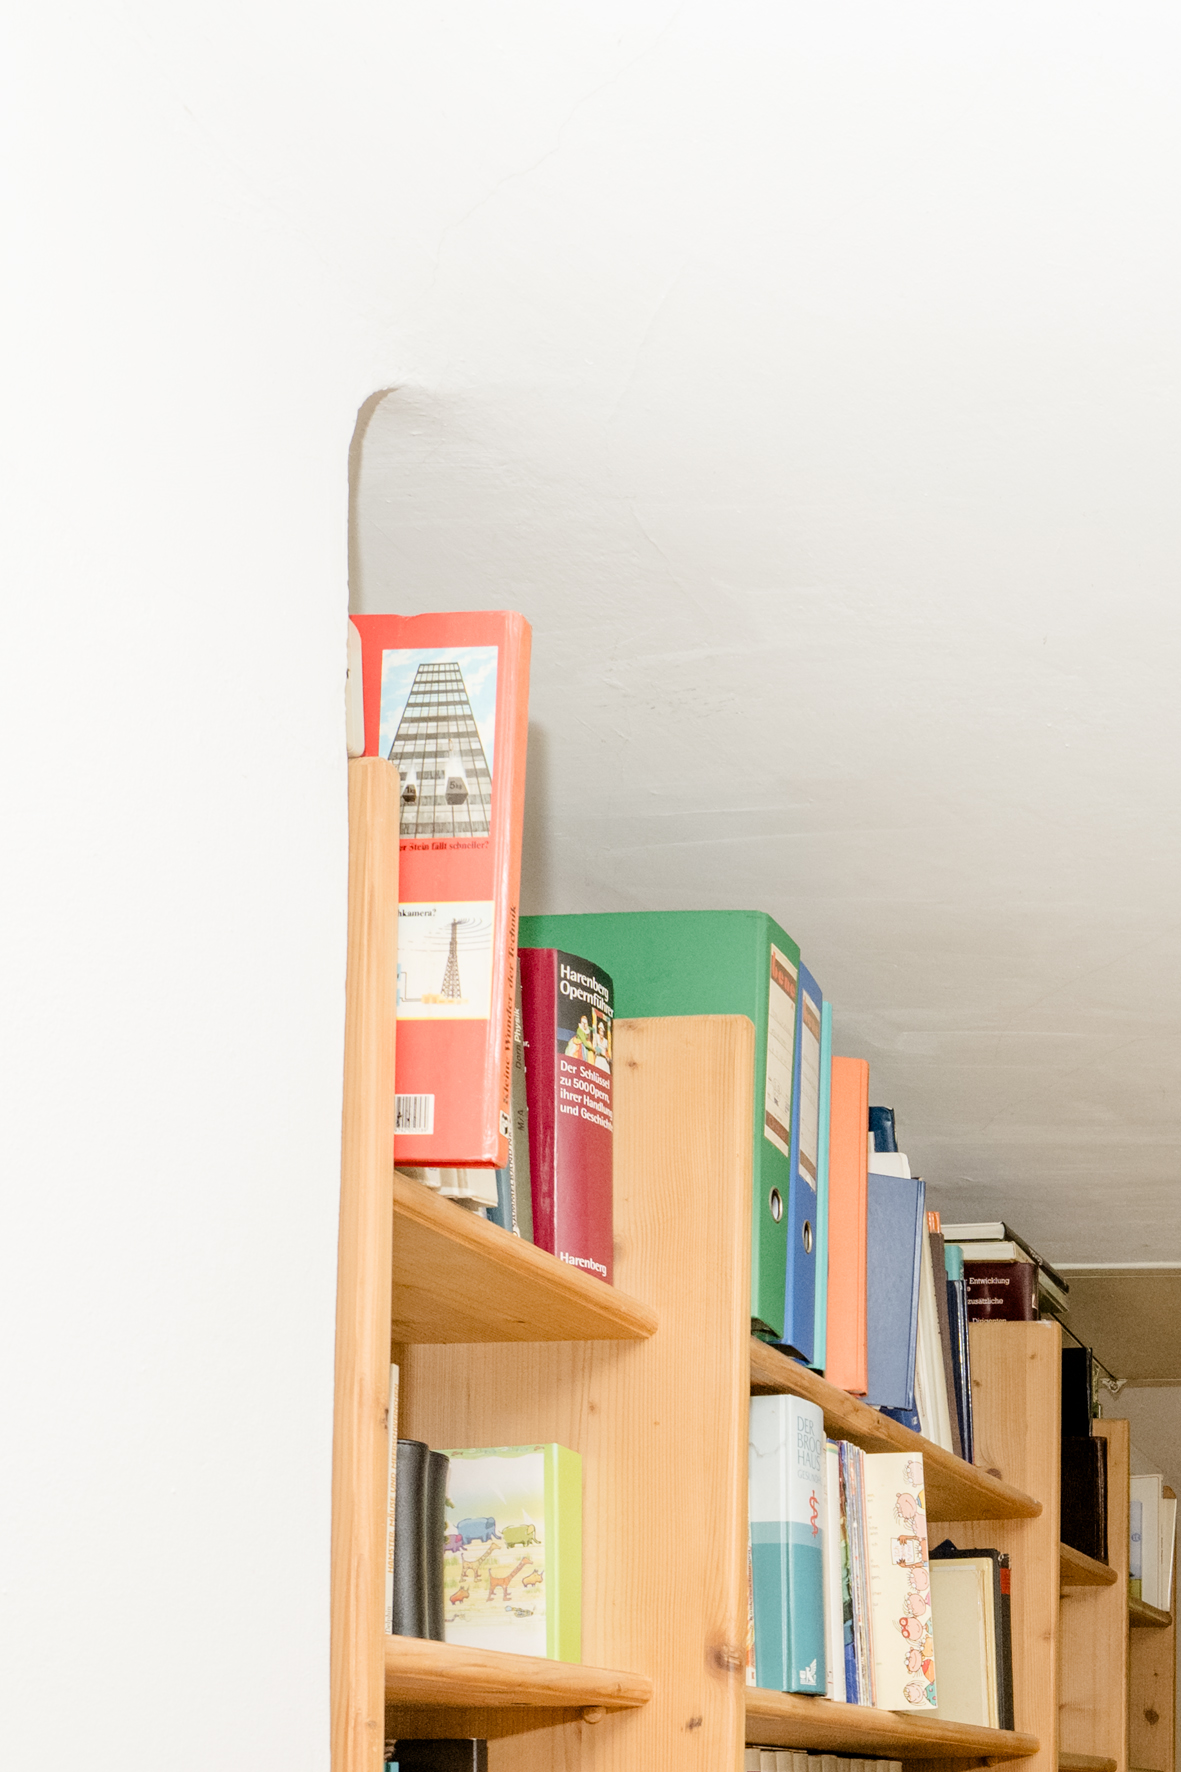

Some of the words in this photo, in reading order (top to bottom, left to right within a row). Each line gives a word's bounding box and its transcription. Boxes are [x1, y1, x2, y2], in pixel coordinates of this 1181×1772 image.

[560, 963, 609, 1002] Harenberg
[771, 950, 796, 998] bene
[560, 980, 614, 1018] Opernführer
[560, 1060, 577, 1074] Der
[580, 1066, 610, 1090] Schlüssel
[560, 1076, 572, 1086] zu
[573, 1078, 590, 1092] 500
[590, 1084, 610, 1104] Opern,
[560, 1088, 582, 1103] ihrer
[560, 1104, 579, 1116] und
[559, 1252, 607, 1277] Harenberg
[969, 1277, 1010, 1286] Entwicklung
[797, 1416, 815, 1436] DER
[797, 1448, 820, 1472] HAUS
